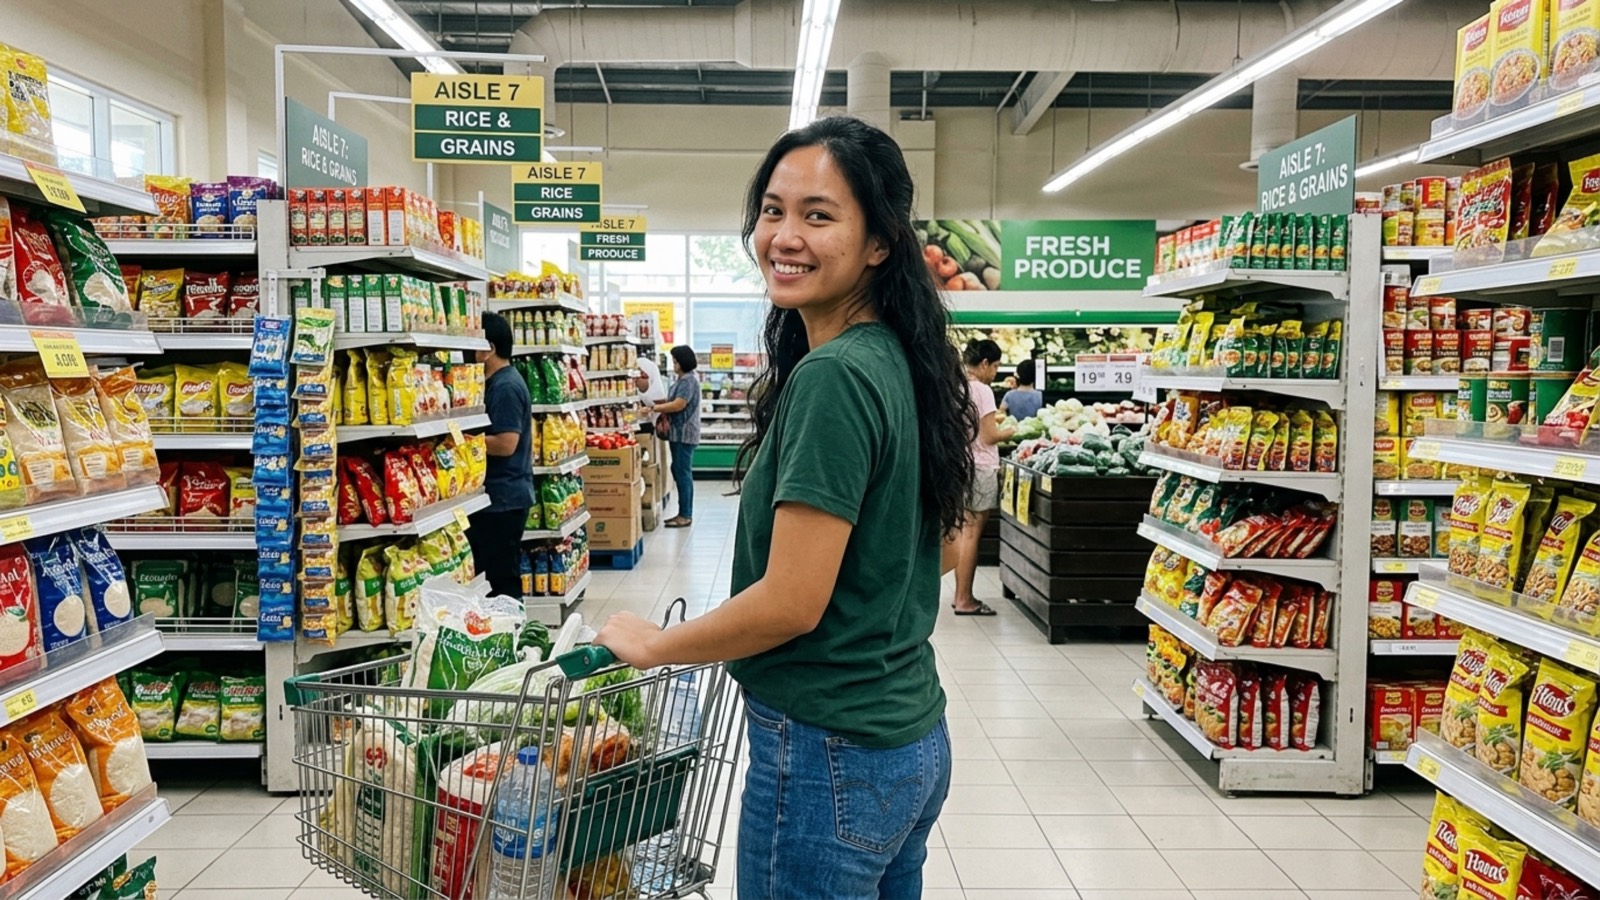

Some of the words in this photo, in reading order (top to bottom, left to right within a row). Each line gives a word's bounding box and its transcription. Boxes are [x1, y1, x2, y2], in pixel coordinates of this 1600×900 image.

[434, 82, 501, 100] AISLE
[508, 84, 521, 101] 7
[445, 111, 492, 128] RICE
[497, 113, 511, 128] &
[340, 137, 349, 160] 7:
[440, 138, 516, 156] GRAINS
[301, 147, 321, 172] RICE
[1279, 149, 1312, 179] AISLE
[1314, 142, 1326, 166] 7:
[527, 167, 573, 179] AISLE
[578, 167, 586, 179] 7
[541, 187, 573, 198] RICE
[1261, 185, 1286, 212] RICE
[1288, 182, 1297, 205] &
[1300, 163, 1348, 201] GRAINS
[531, 207, 583, 219] GRAINS
[628, 220, 635, 229] 7
[596, 234, 630, 244] FRESH
[1026, 236, 1110, 255] FRESH
[588, 249, 638, 259] PRODUCE
[1014, 259, 1142, 279] PRODUCE
